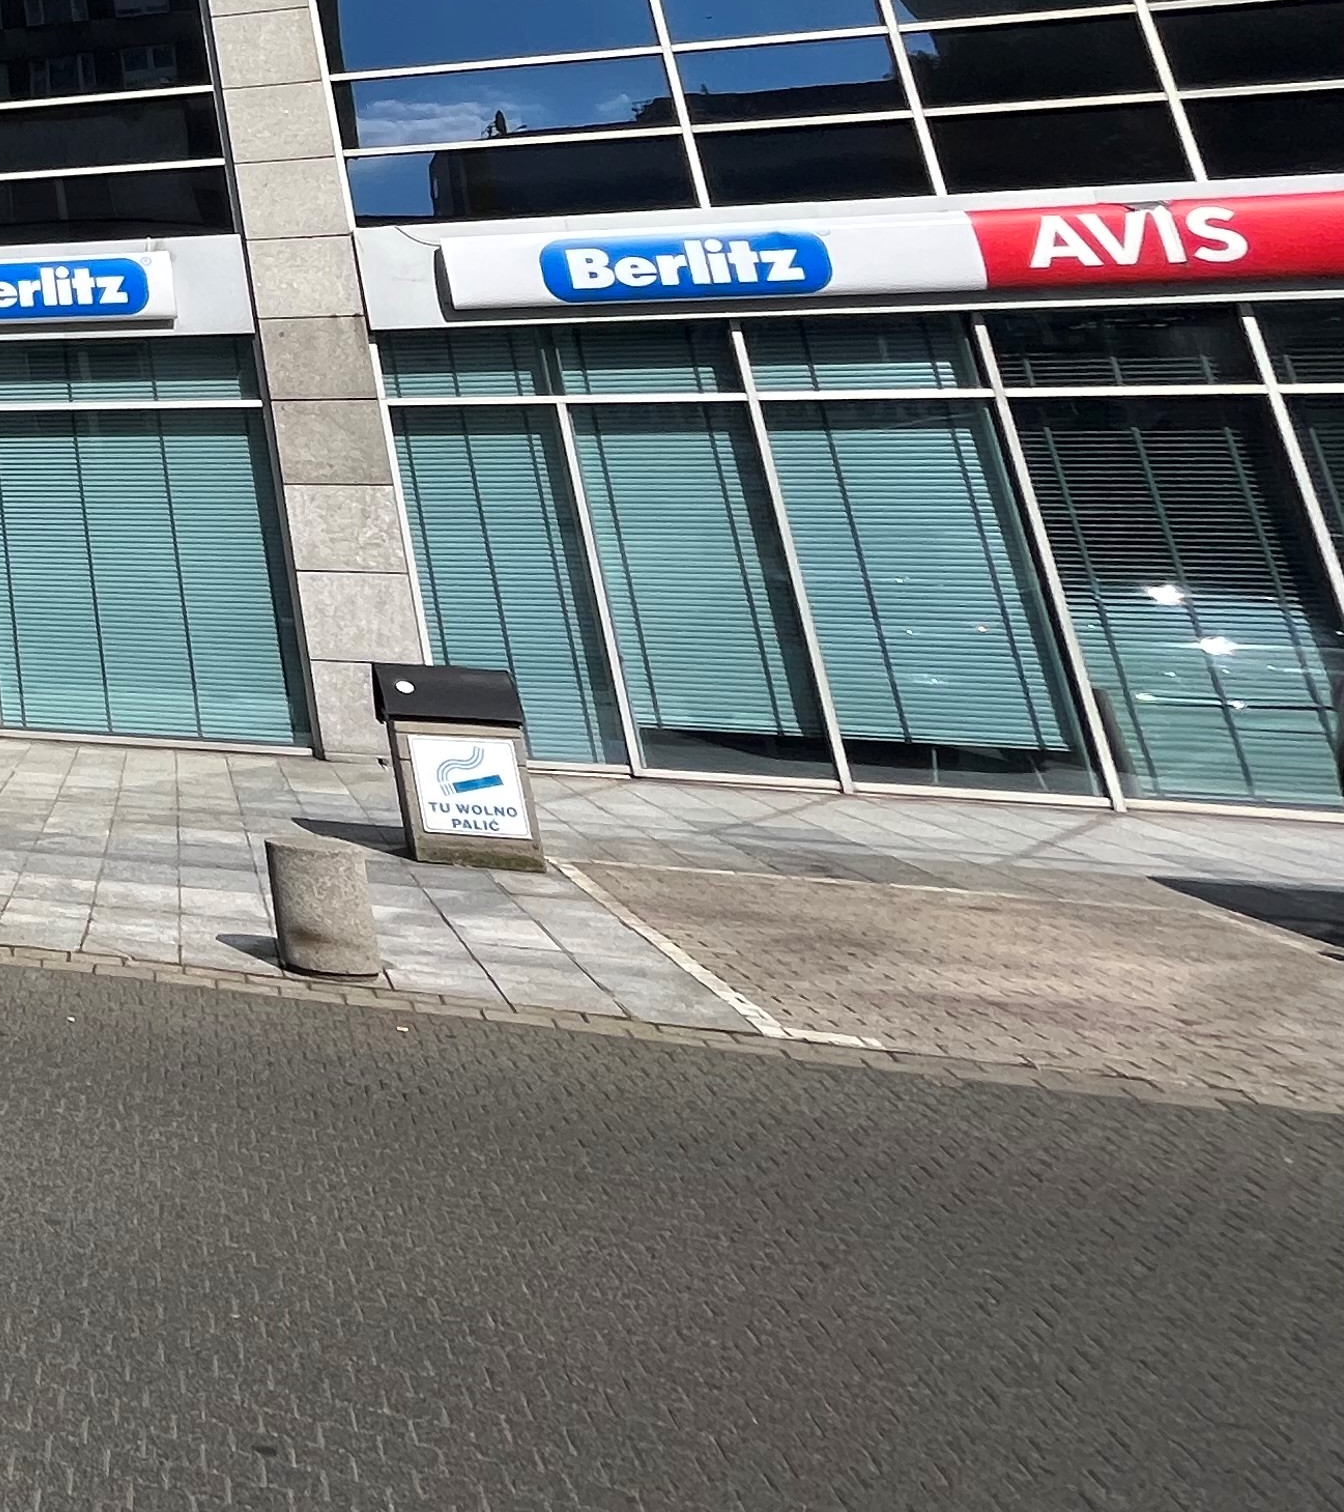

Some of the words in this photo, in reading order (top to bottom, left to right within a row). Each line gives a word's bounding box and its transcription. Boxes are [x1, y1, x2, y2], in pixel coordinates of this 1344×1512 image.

[1030, 205, 1249, 269] AVIS
[565, 238, 806, 290] Berlitz
[428, 801, 451, 813] TU
[456, 803, 518, 818] WOLNO
[452, 818, 501, 832] PALIĆ
